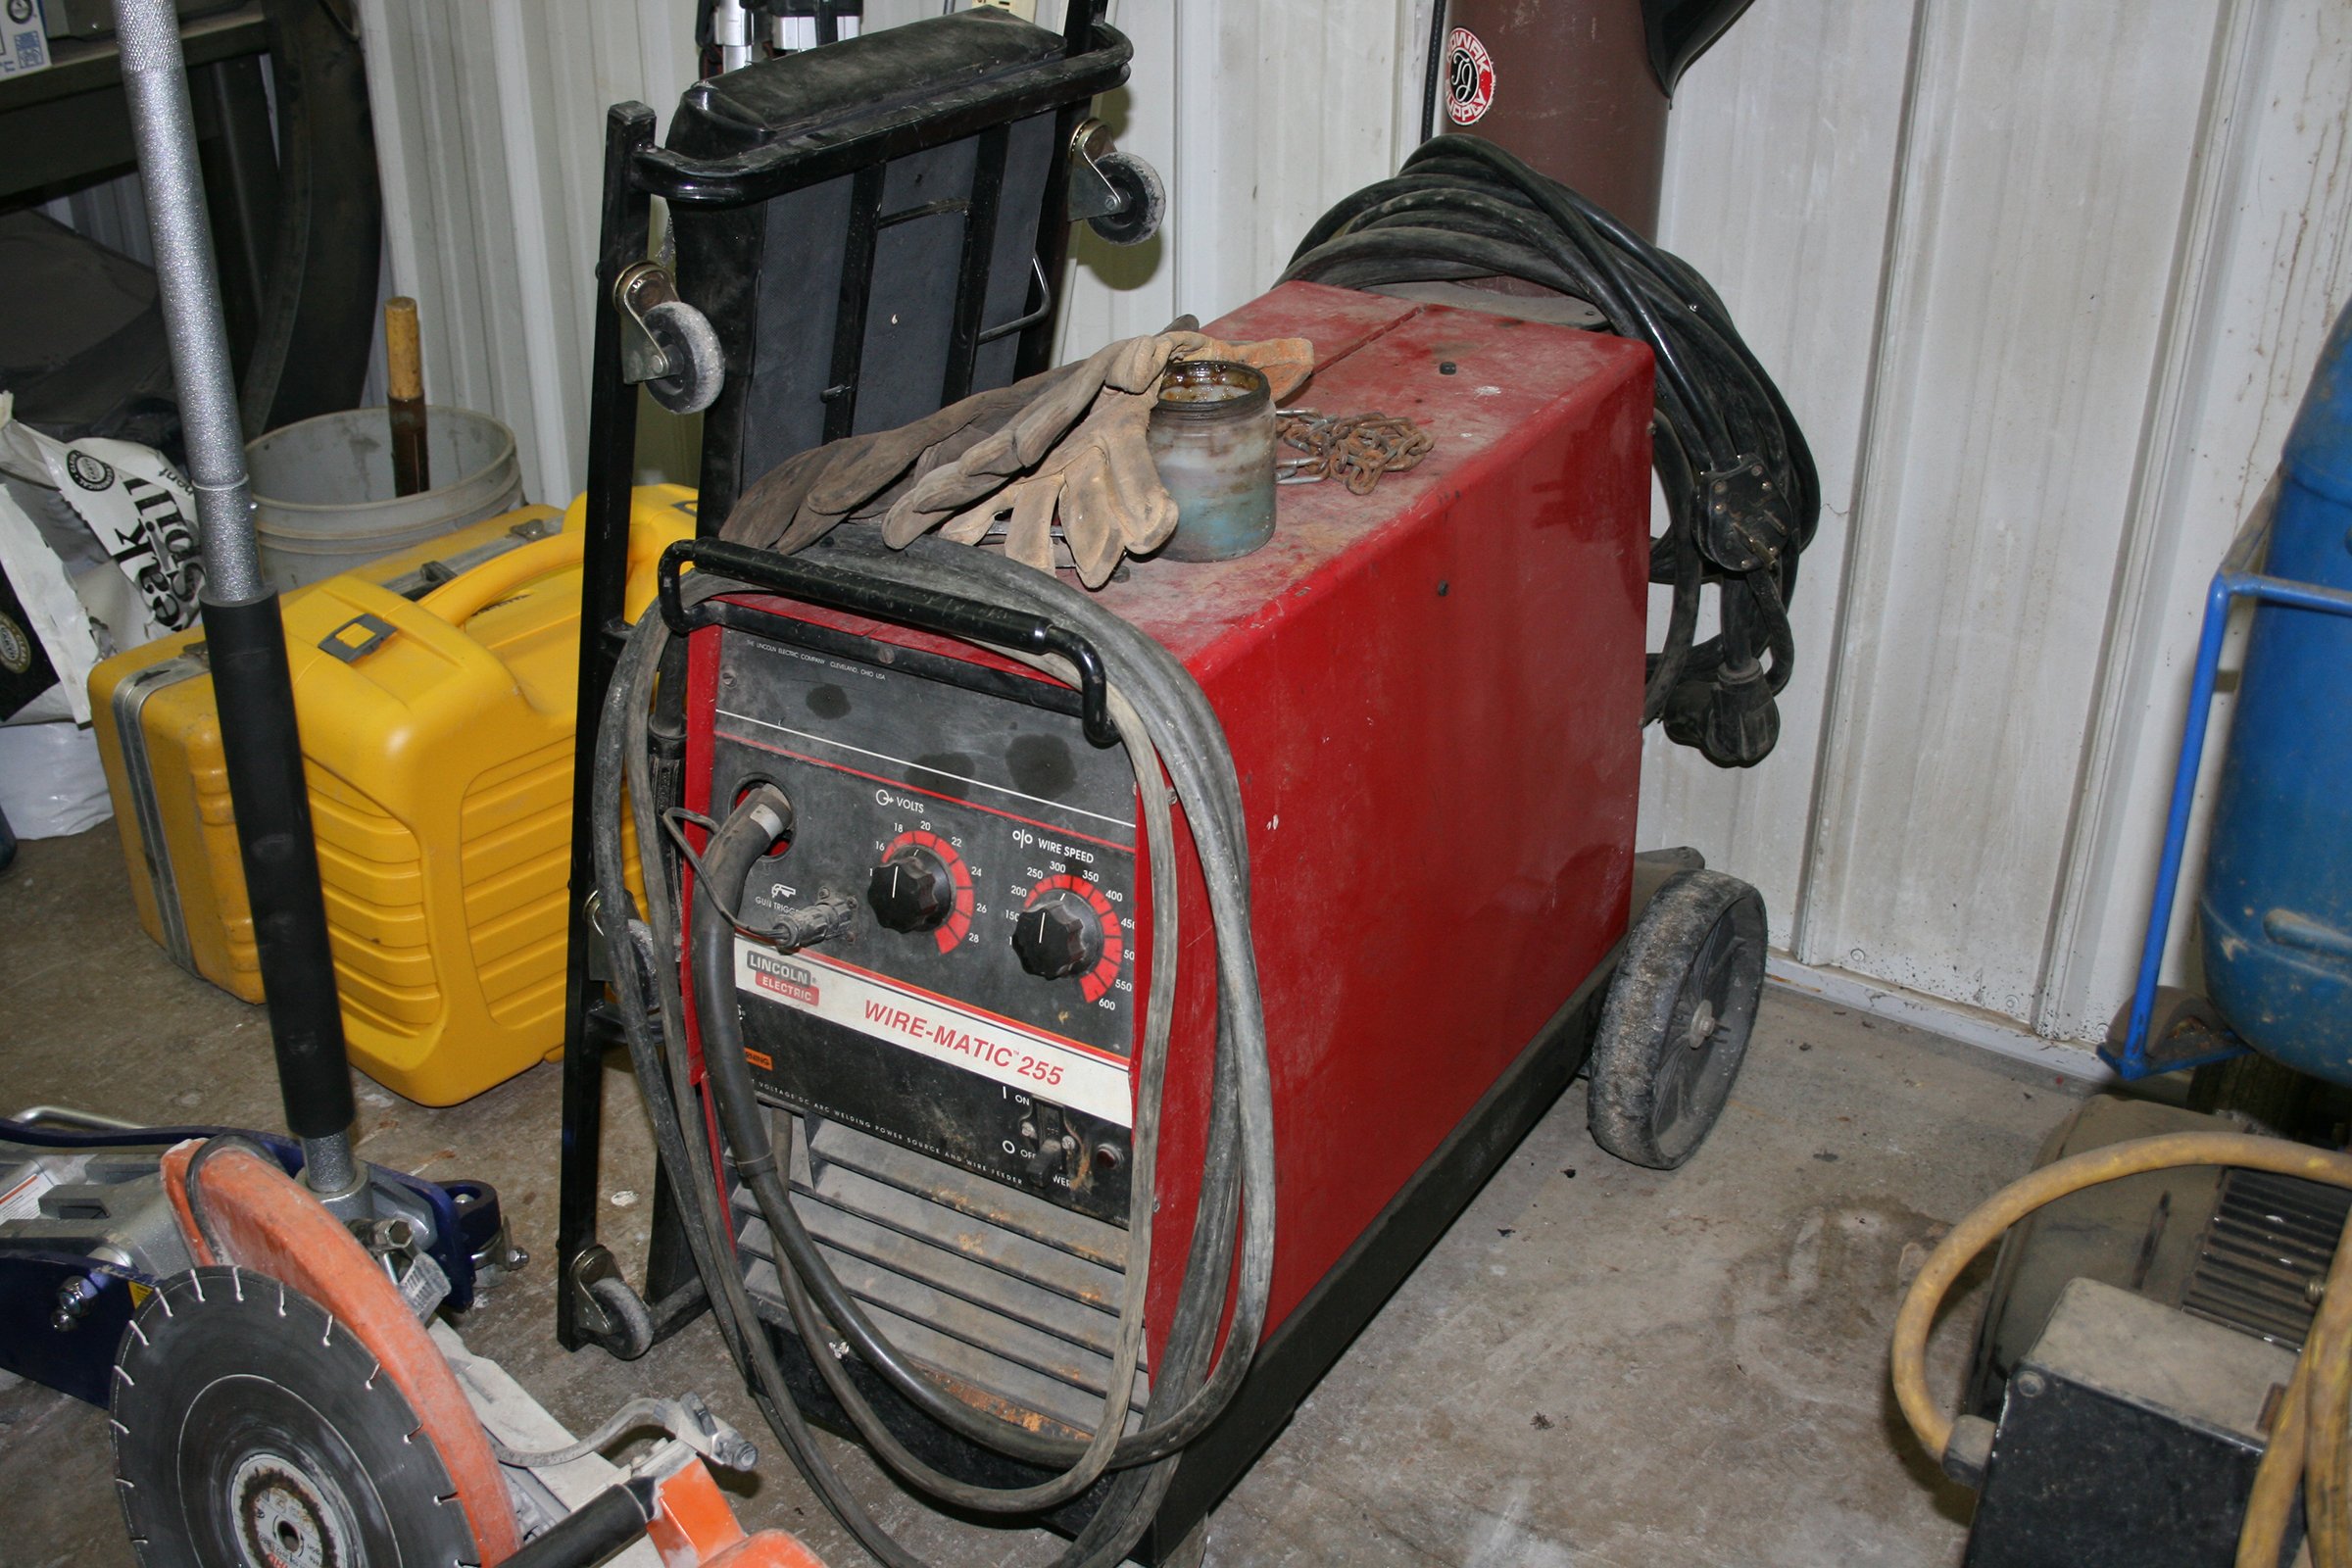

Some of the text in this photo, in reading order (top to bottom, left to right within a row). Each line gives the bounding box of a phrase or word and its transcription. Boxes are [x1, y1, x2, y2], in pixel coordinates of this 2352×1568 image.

[757, 643, 777, 653] LINCOLN
[778, 648, 799, 659] ELECTRIC
[801, 654, 825, 664] COMPANY
[860, 668, 874, 678] OHIO
[896, 796, 924, 813] VOLTS
[894, 822, 904, 833] 18
[920, 820, 931, 831] 20
[875, 841, 885, 852] 16
[951, 836, 962, 848] 22
[1038, 837, 1094, 864] WIRE SPEED
[971, 866, 982, 877] 24
[1026, 866, 1044, 880] 250
[1049, 860, 1066, 873] 300
[1082, 869, 1100, 882] 350
[1010, 884, 1027, 898] 200
[1105, 889, 1123, 902] 400
[773, 902, 800, 916] TRIGG
[976, 903, 987, 913] 26
[968, 932, 979, 944] 28
[750, 954, 808, 984] LINCOLN
[761, 975, 812, 1001] ELECTRIC
[1114, 979, 1132, 992] 550
[1099, 998, 1115, 1011] 600
[1017, 1055, 1064, 1086] 255
[1014, 1094, 1030, 1105] ON
[759, 1082, 1023, 1185] VOLTAGE DC ARC WELDING POWER SOURCE AND WIRE FEEDER
[1020, 1149, 1037, 1159] OFF
